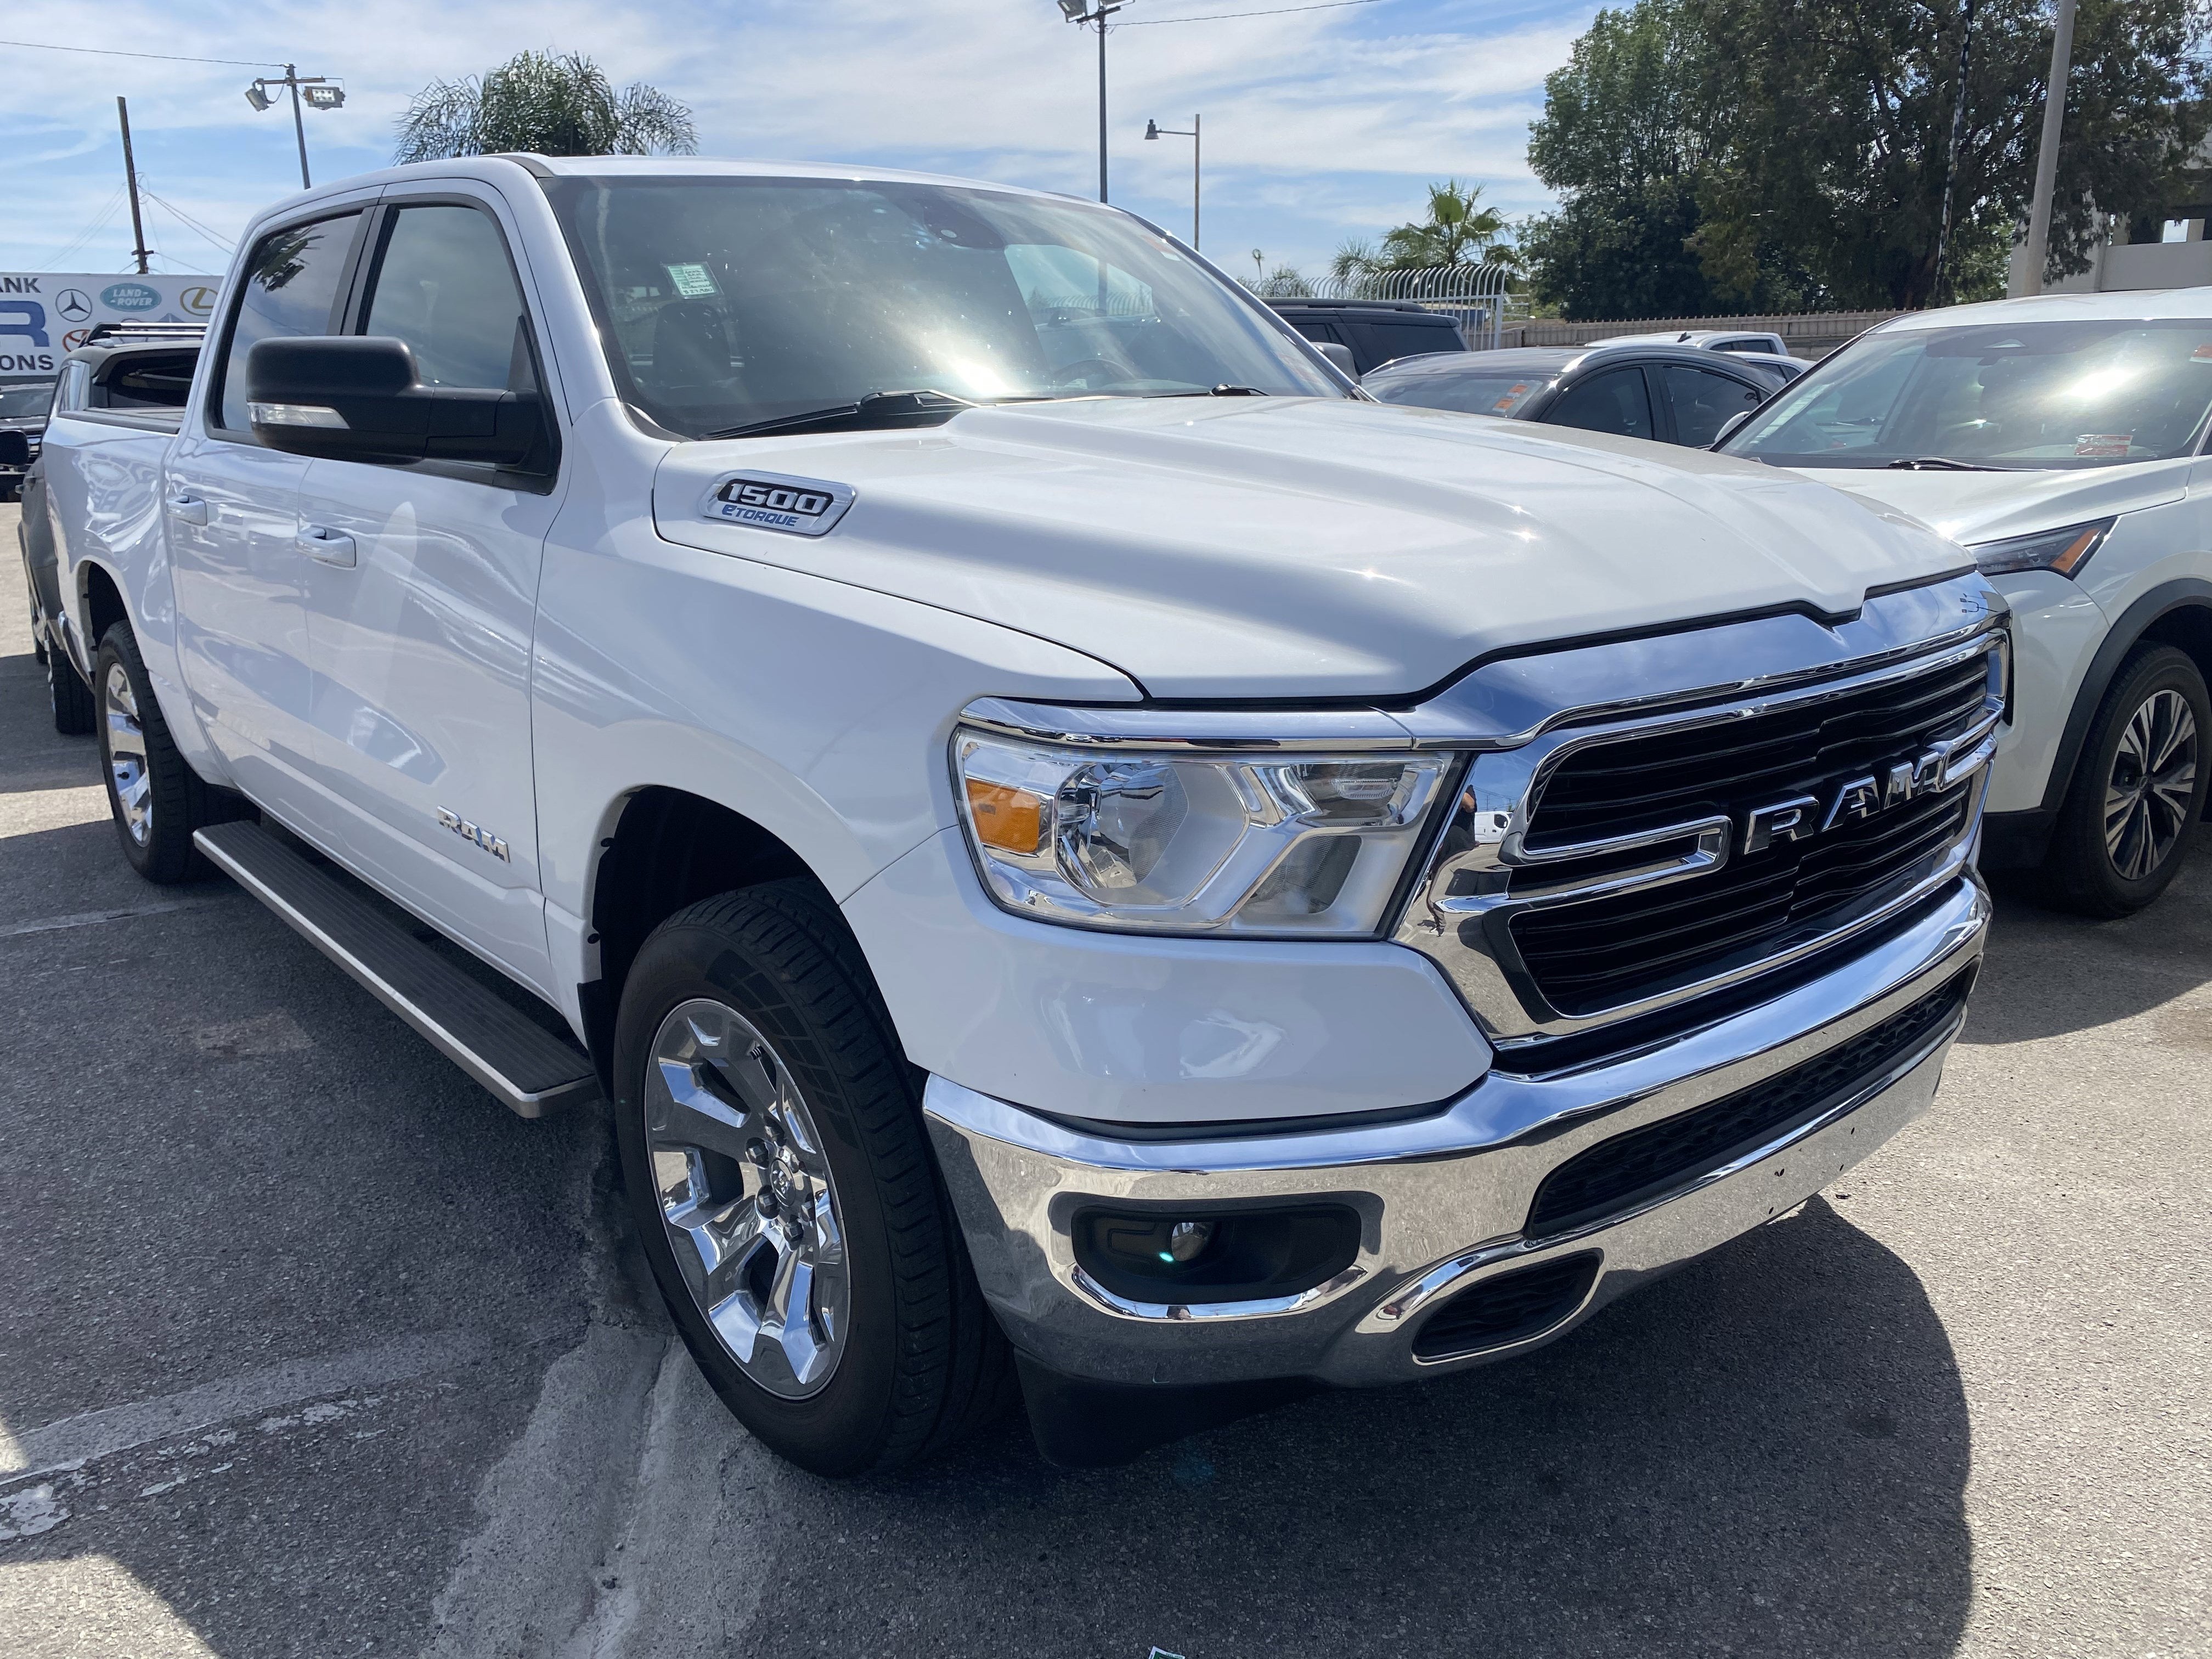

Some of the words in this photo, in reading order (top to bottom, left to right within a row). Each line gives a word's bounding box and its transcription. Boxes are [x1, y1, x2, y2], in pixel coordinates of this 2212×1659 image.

[0, 277, 41, 293] NK
[0, 354, 53, 370] ONS
[728, 483, 829, 514] 1500
[1743, 751, 1940, 855] RAM
[437, 805, 511, 864] RAM
